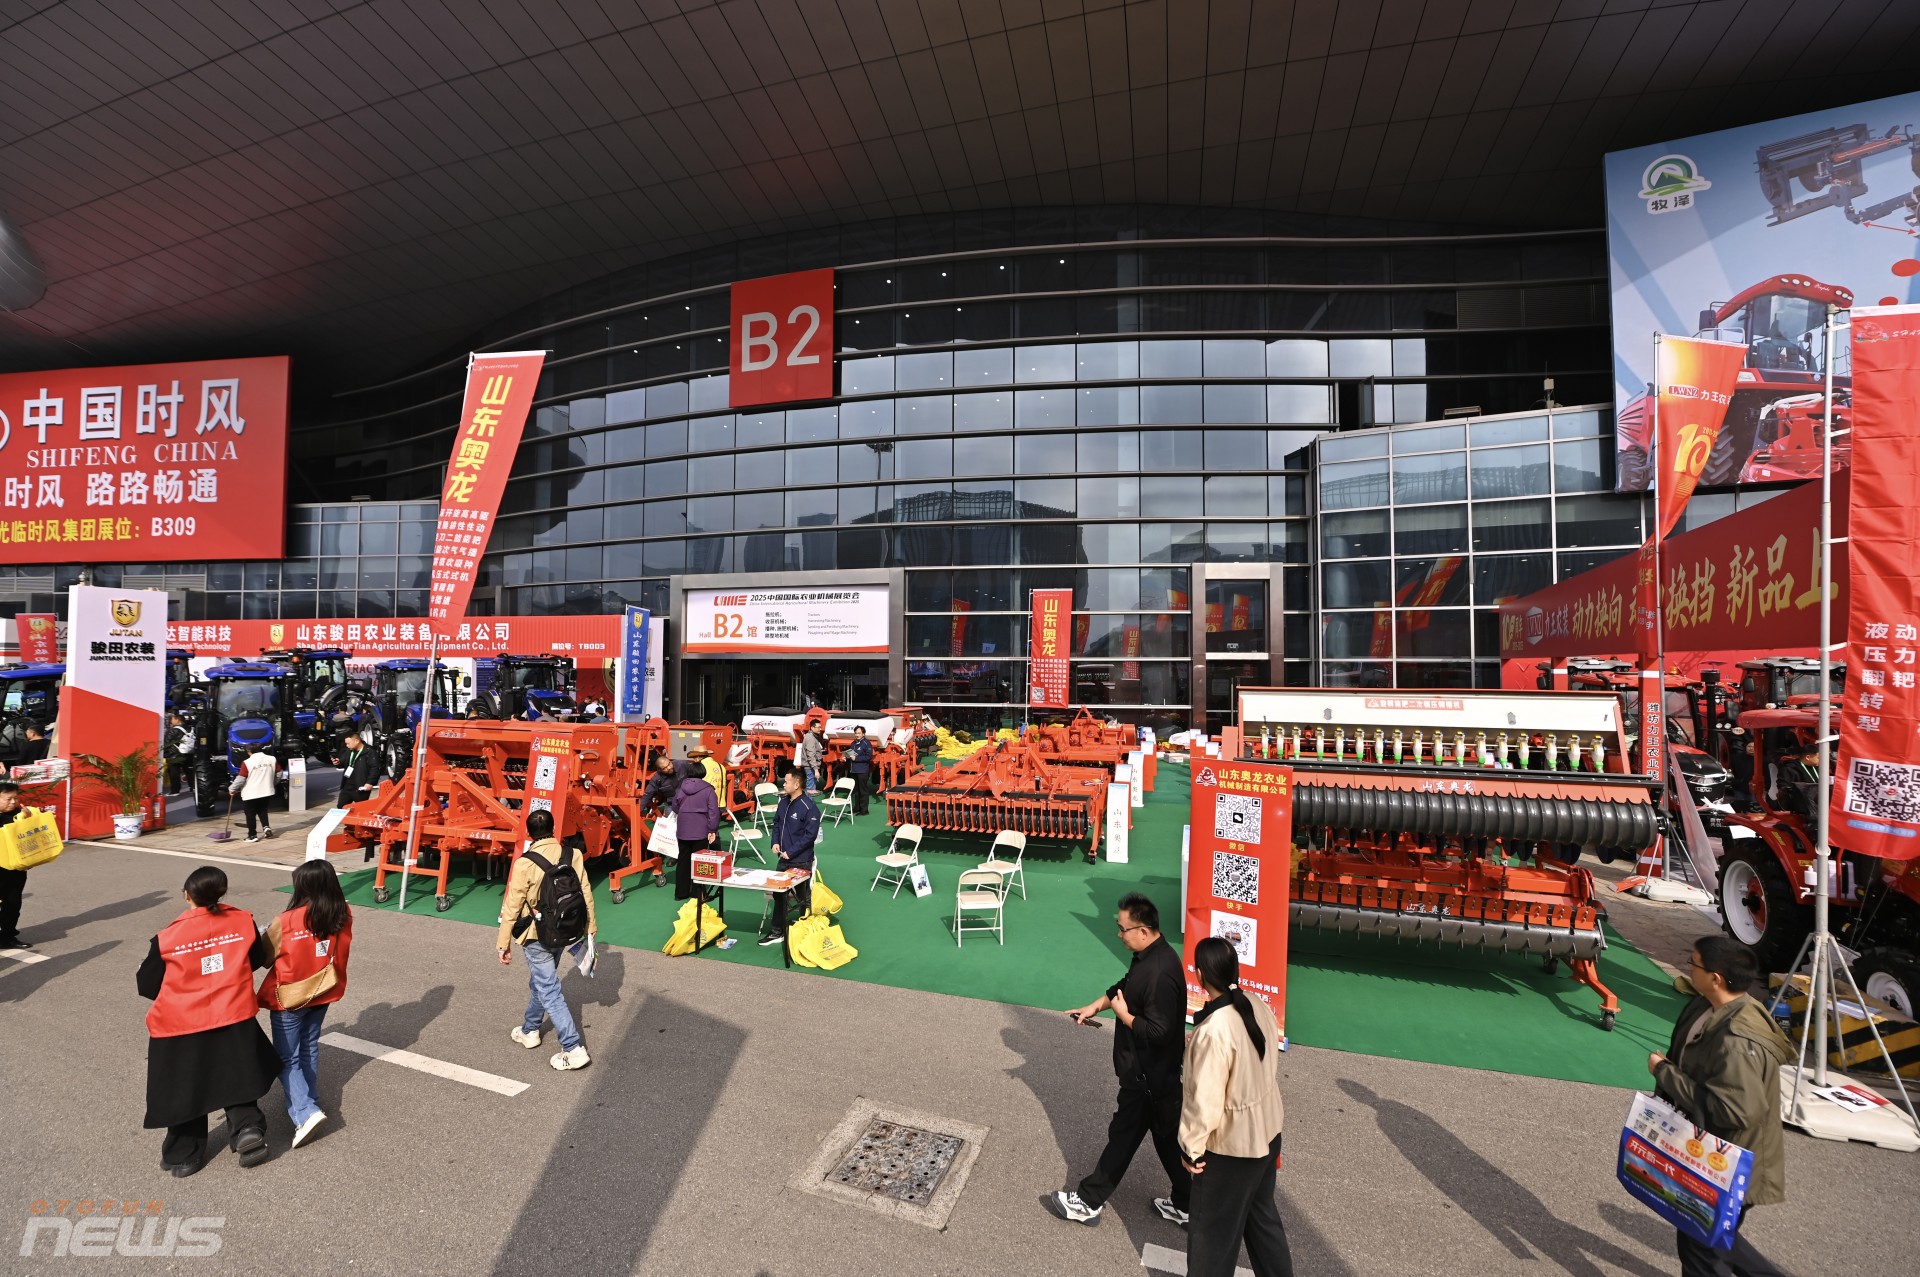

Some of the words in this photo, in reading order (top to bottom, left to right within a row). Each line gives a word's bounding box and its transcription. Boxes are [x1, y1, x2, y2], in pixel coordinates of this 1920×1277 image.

[1650, 194, 1690, 211] 牧泽
[742, 305, 820, 372] B2
[23, 378, 246, 443] 中国时风
[445, 375, 512, 502] 山东奥龙
[26, 445, 138, 468] SHIFENG
[153, 440, 238, 463] CHINA
[4, 475, 64, 509] 时风
[86, 468, 218, 507] 路路畅通
[151, 516, 196, 536] B309
[1572, 584, 1622, 640] 动力换向
[714, 613, 743, 638] B2
[747, 626, 758, 638] 馆
[1042, 599, 1058, 657] 山东奥龙
[91, 642, 155, 654] 骏田农装
[472, 642, 490, 651] Co.,
[492, 642, 510, 650] Ltd.
[1892, 623, 1918, 689] 动力耙
[1856, 622, 1890, 732] 液压翻转犁
[1218, 768, 1287, 785] 山东奥龙农业
[1218, 780, 1287, 796] 机械制造有限公司
[1422, 780, 1474, 792] 山东奥龙
[1229, 841, 1245, 852] 微信
[1226, 901, 1243, 912] 快手
[1630, 1138, 1676, 1176] 开元新一代
